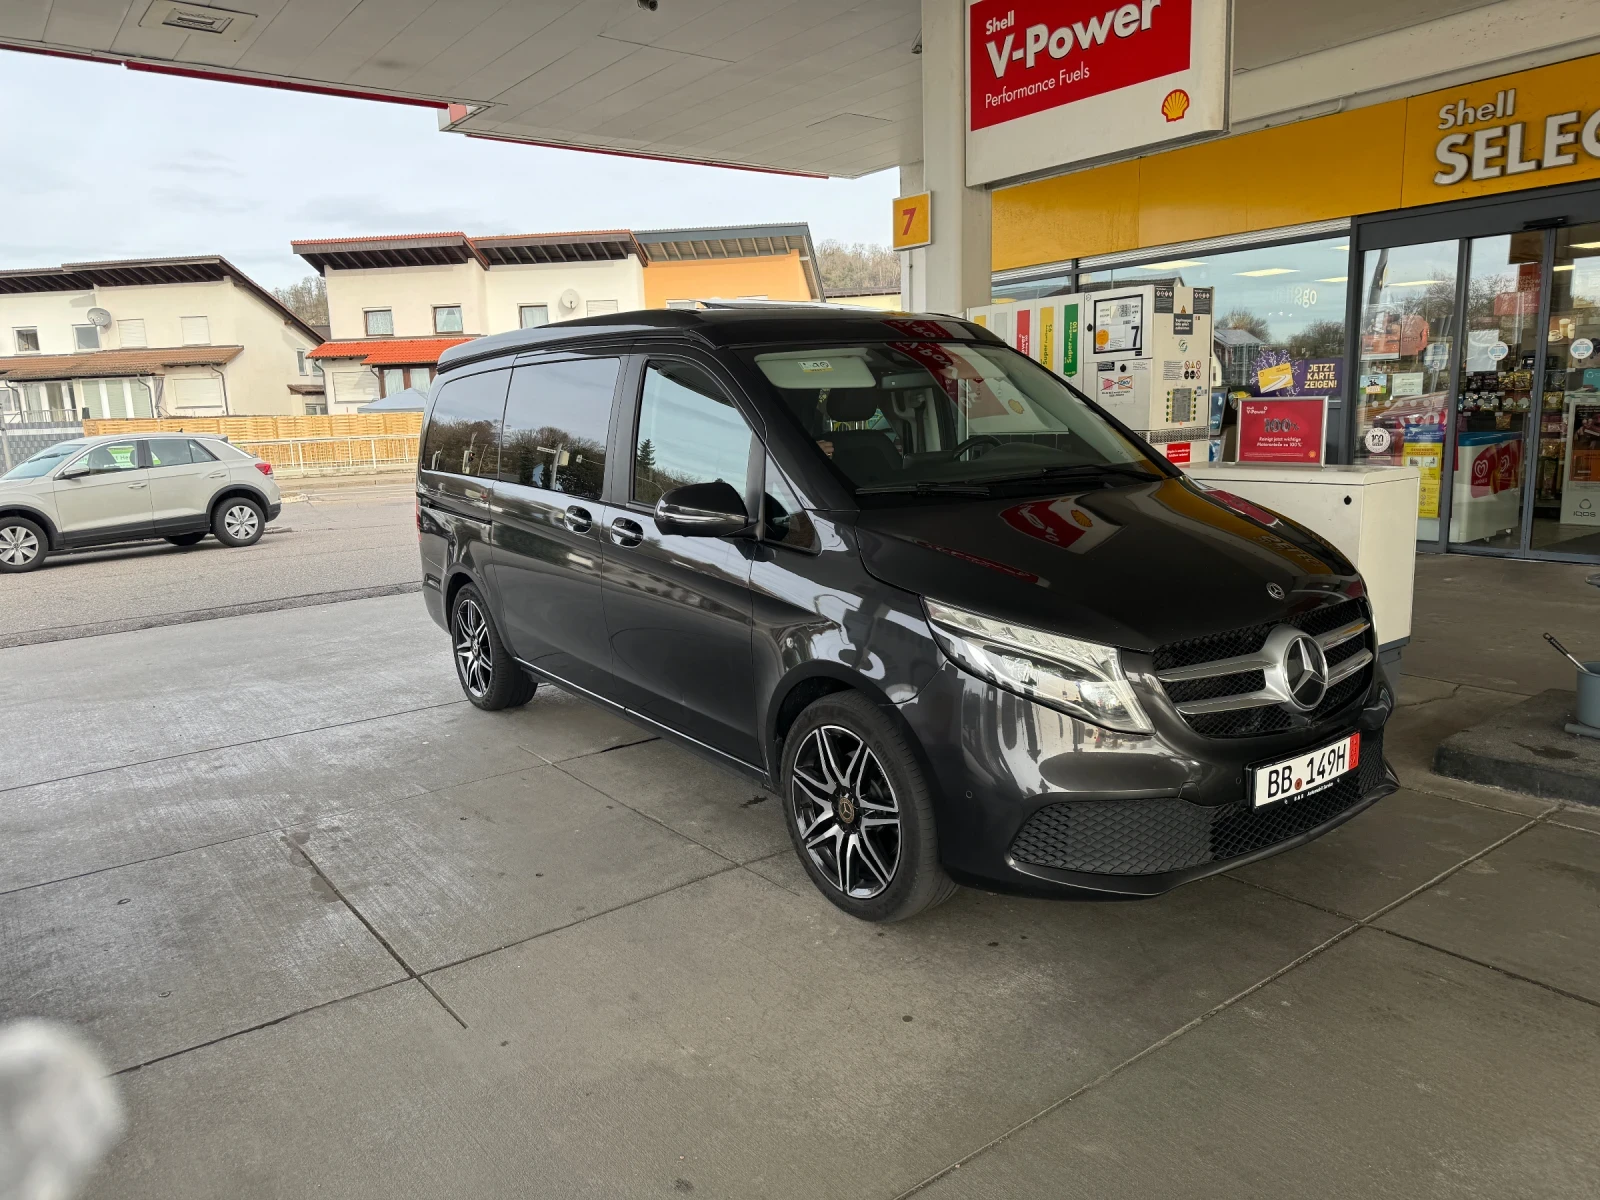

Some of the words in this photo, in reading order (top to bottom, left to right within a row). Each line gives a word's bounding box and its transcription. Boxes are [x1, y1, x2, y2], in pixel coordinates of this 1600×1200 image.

[985, 10, 1015, 35] Shell
[985, 0, 1162, 79] V-Power
[985, 77, 1056, 109] Performance
[1059, 61, 1090, 86] Fuels
[1437, 88, 1516, 130] Shell
[902, 207, 917, 236] 7
[1131, 325, 1140, 347] 7
[1307, 371, 1336, 381] KARTE
[1308, 363, 1336, 373] JETZT
[1304, 379, 1338, 389] ZEIGEN!
[1573, 510, 1597, 518] IQOS
[1267, 765, 1293, 799] BB
[1305, 743, 1347, 786] 149H
